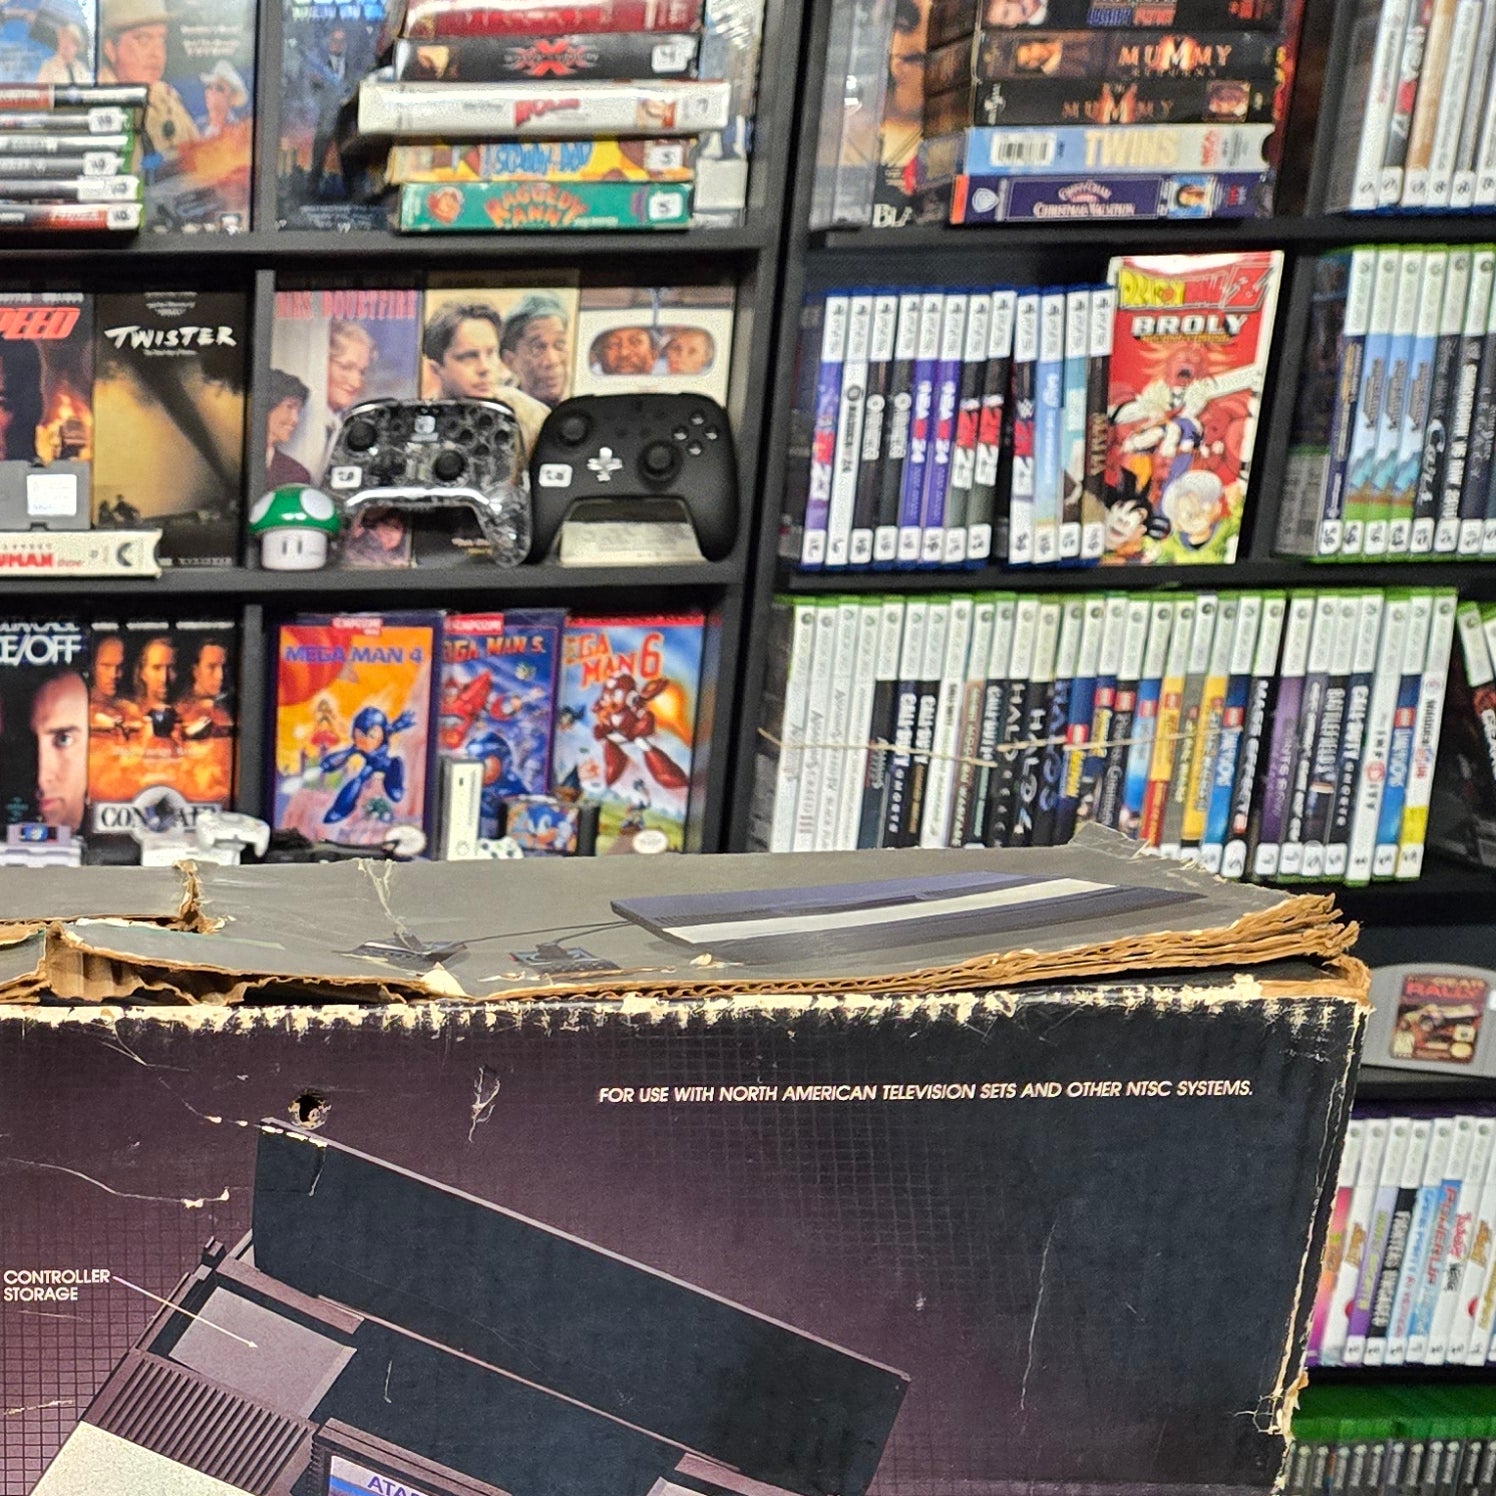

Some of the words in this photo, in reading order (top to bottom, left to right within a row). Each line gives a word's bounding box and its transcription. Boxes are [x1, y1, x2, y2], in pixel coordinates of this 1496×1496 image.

[1118, 35, 1232, 70] MUMMY
[1061, 83, 1174, 124] MUMMY
[1085, 130, 1182, 167] TWINS
[1132, 315, 1249, 337] BROLY
[104, 326, 237, 349] TWISTER
[284, 645, 346, 663] MEGA
[351, 645, 404, 663] MAN
[409, 647, 423, 663] 4
[444, 640, 478, 662] EGA
[639, 633, 665, 680] 6
[101, 807, 142, 828] CON
[599, 1087, 637, 1103] FOR
[640, 1087, 669, 1103] USE
[674, 1086, 716, 1102] WITH
[719, 1085, 778, 1101] NORTH
[783, 1084, 877, 1101] AMERICAN
[882, 1083, 976, 1100] TELEVISION
[980, 1083, 1018, 1098] SETS
[1022, 1081, 1062, 1098] AND
[1066, 1080, 1122, 1097] OTHER
[1126, 1080, 1173, 1096] NTSC
[1177, 1079, 1254, 1097] SYSTEMS.
[4, 1268, 110, 1285] CONTROLLER
[4, 1285, 78, 1302] STORAGE
